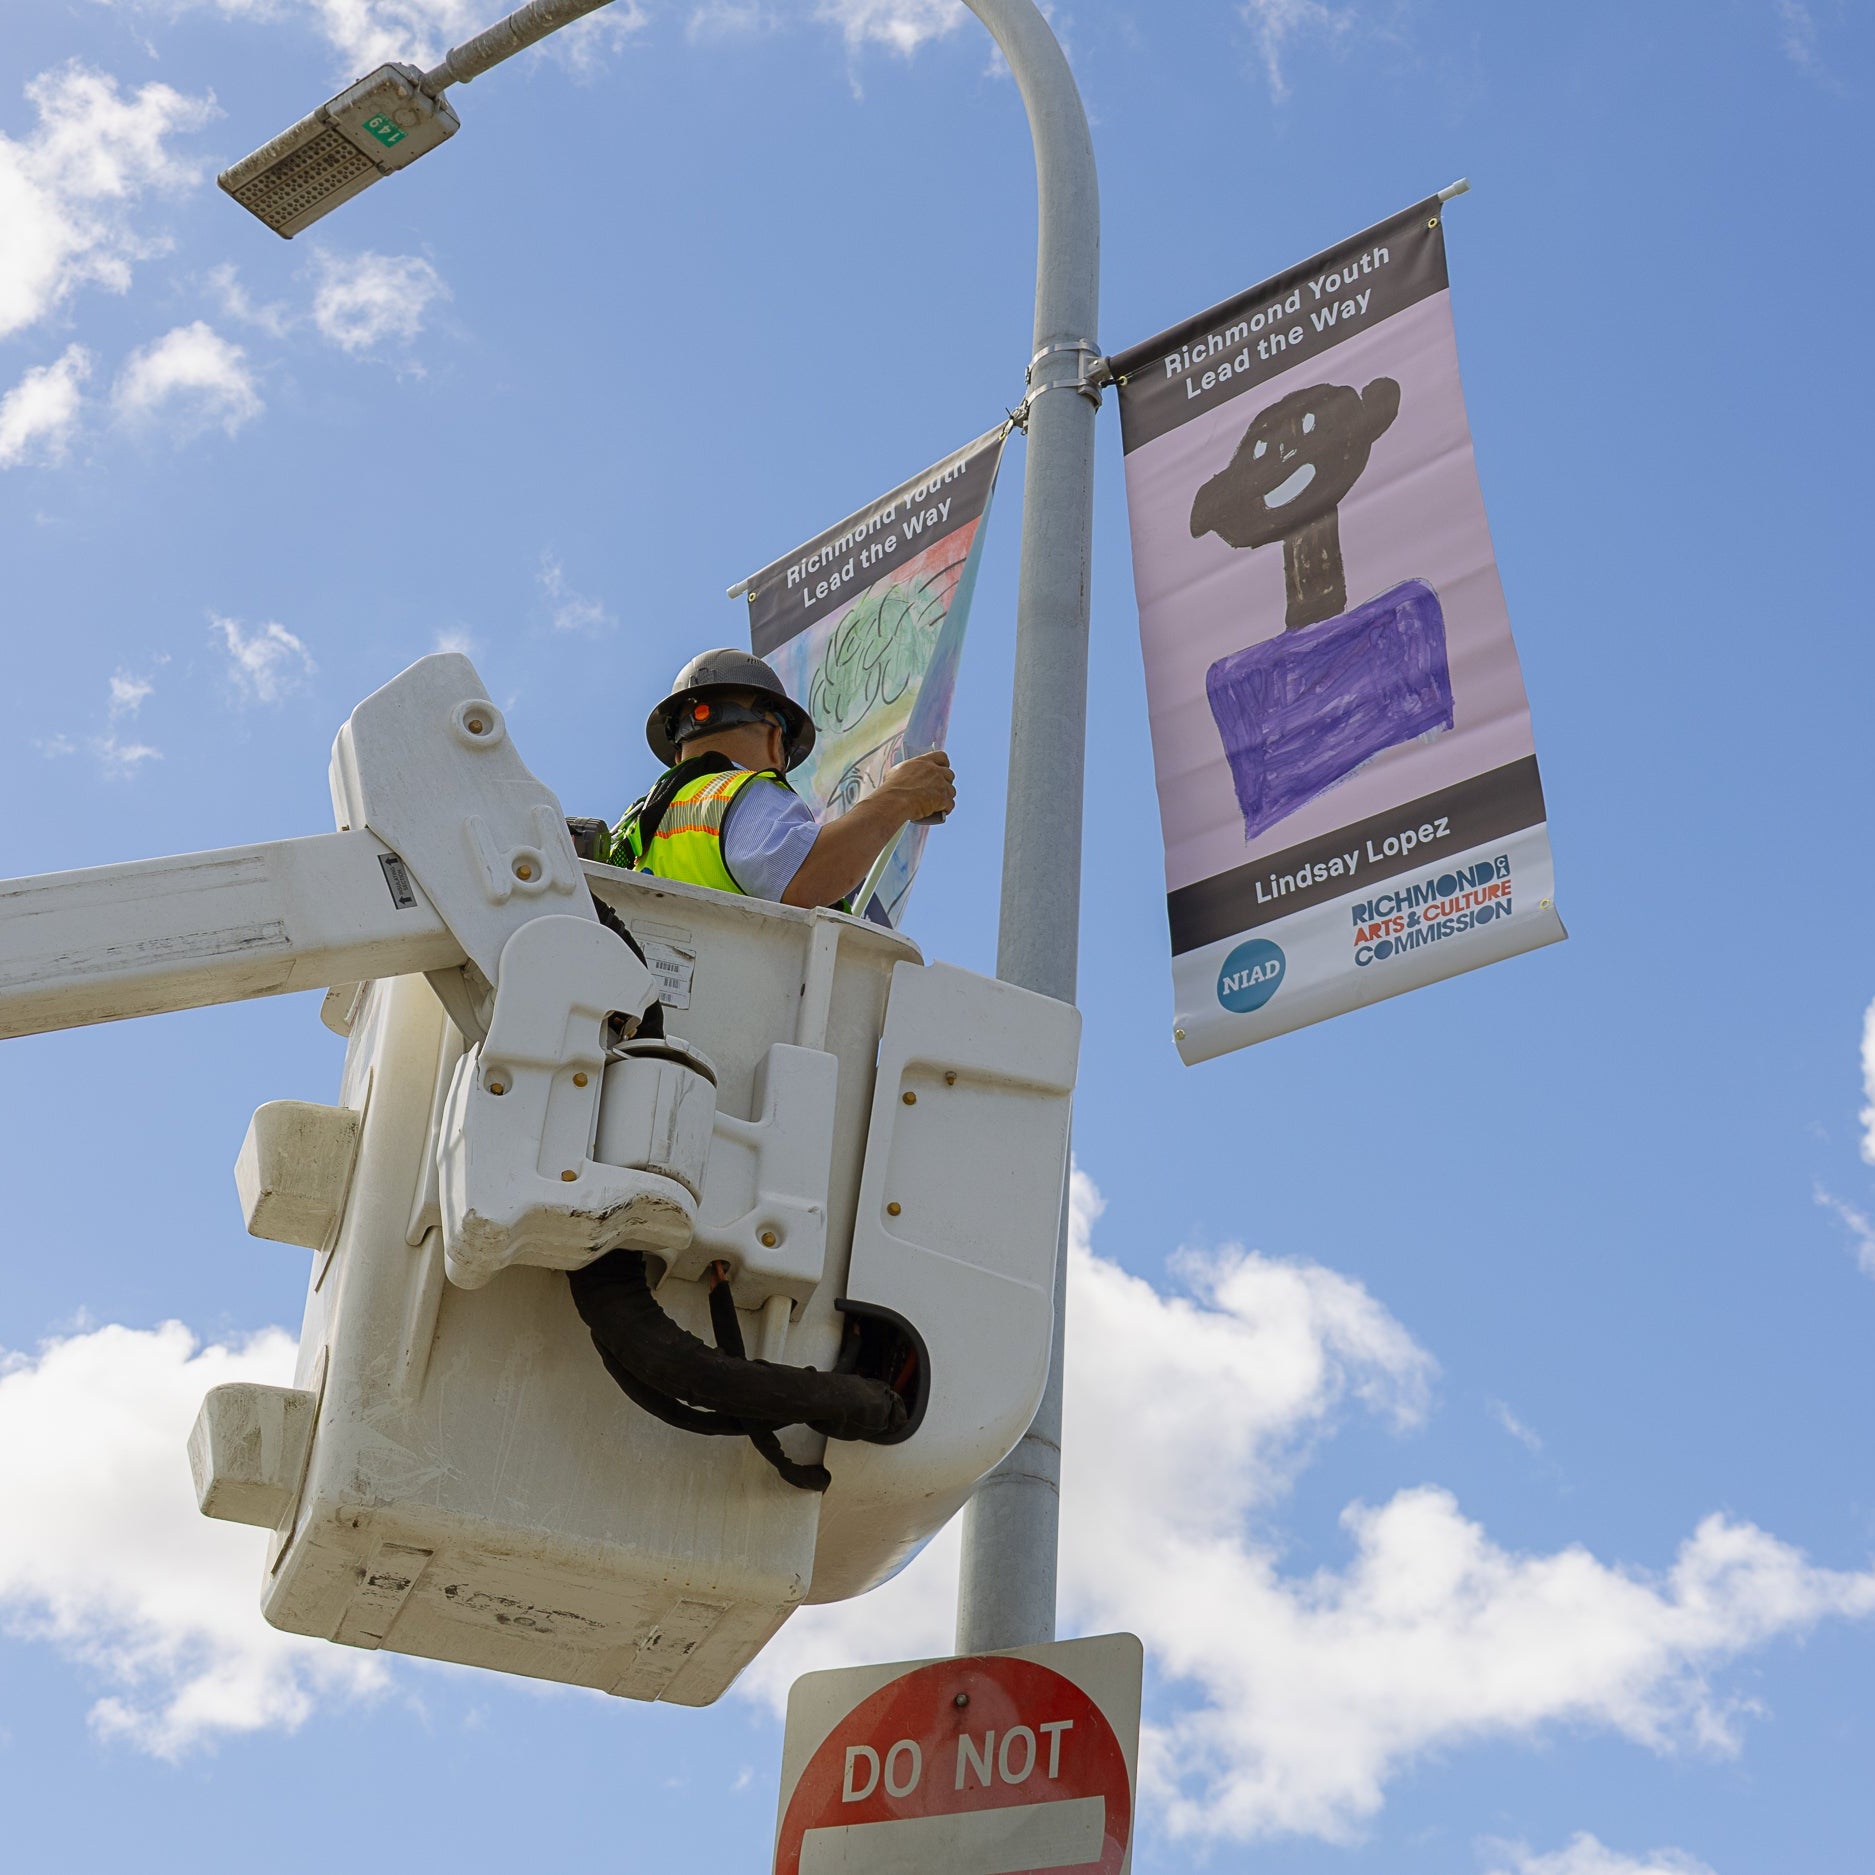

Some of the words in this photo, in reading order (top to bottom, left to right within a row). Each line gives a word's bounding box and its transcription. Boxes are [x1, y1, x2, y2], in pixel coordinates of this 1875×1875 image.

[369, 117, 400, 142] 149
[1163, 289, 1300, 379] Richmond
[1308, 247, 1389, 301] Youth
[1185, 349, 1250, 400] Lead
[1257, 323, 1304, 361] the
[1310, 288, 1372, 333] Way
[787, 502, 896, 589] Richmond
[802, 559, 854, 608] Lead
[860, 535, 897, 568] the
[902, 497, 952, 540] Way
[1255, 848, 1359, 904] Lindsay
[1366, 816, 1450, 864] Lopez
[1351, 861, 1495, 926] RICHMOND
[1354, 915, 1405, 947] ARTS
[1423, 879, 1512, 922] CULTURE
[1354, 898, 1512, 967] COMMISSION
[1223, 959, 1280, 995] NIAD
[842, 1739, 922, 1803] DO
[954, 1720, 1074, 1791] NOT
